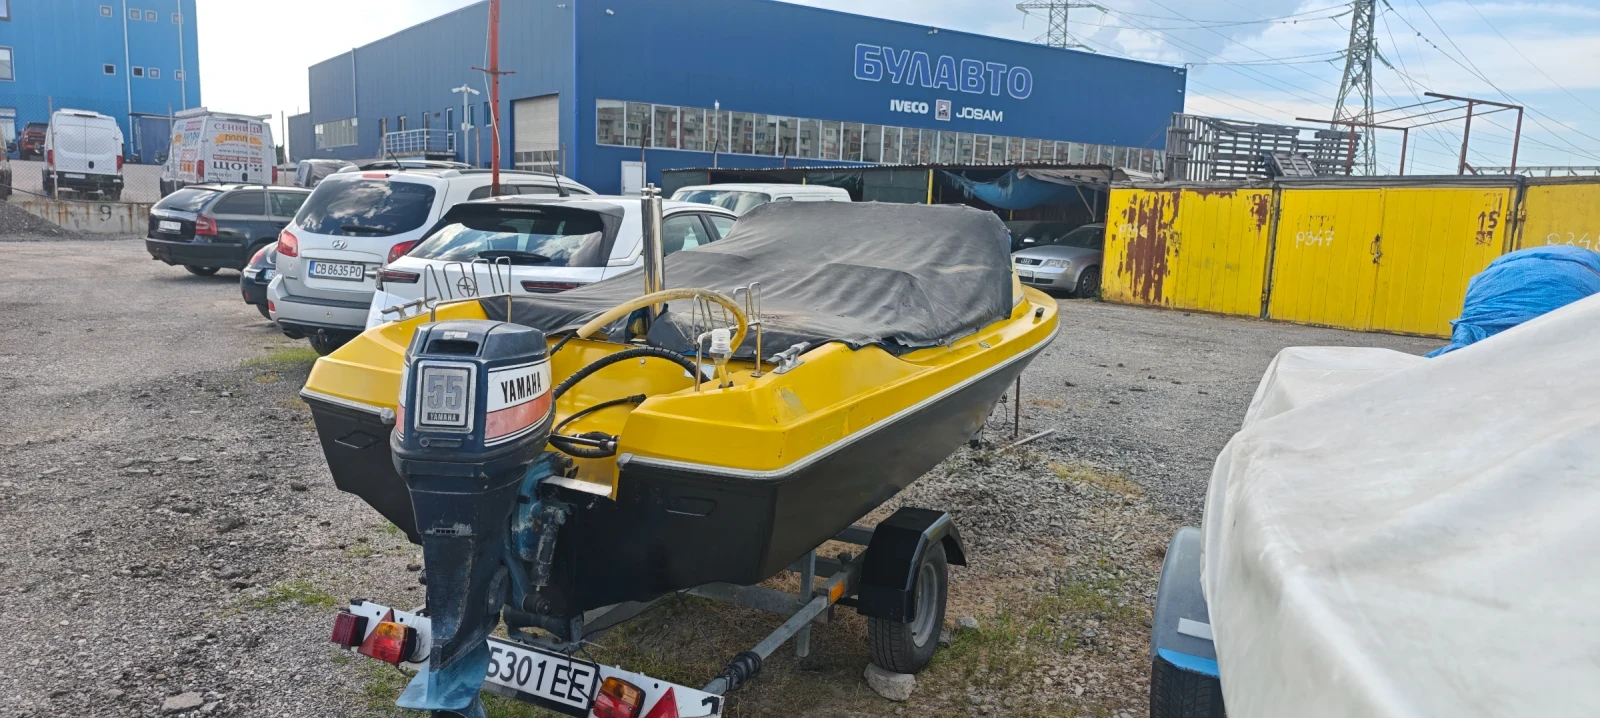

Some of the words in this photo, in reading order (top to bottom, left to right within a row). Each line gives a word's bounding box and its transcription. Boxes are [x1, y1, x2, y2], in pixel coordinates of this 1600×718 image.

[854, 43, 1033, 99] БУЛАВТО
[889, 99, 929, 114] IVECO
[956, 107, 1003, 122] JOSAM
[100, 205, 111, 221] 9
[328, 264, 348, 276] 8635
[427, 374, 463, 410] 55
[500, 371, 542, 403] YAMAHA
[430, 413, 457, 421] YAMAHA
